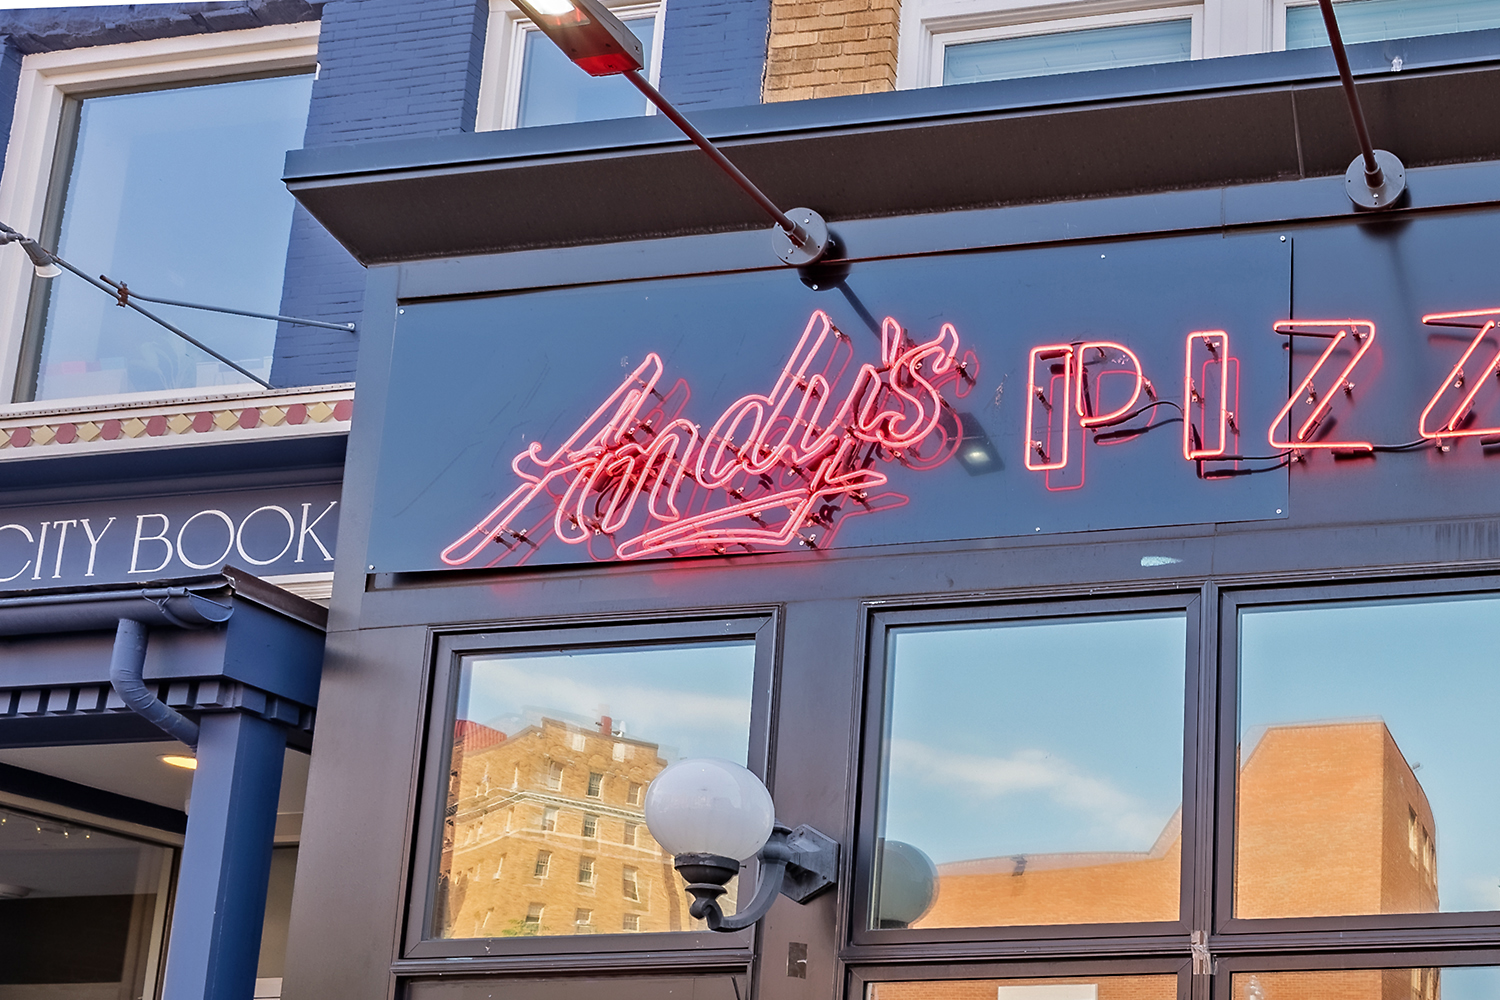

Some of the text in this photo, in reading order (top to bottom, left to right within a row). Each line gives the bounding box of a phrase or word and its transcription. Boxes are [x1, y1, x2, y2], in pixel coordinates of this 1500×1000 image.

[440, 309, 960, 566] Andy's
[0, 501, 338, 583] CITY BOOK
